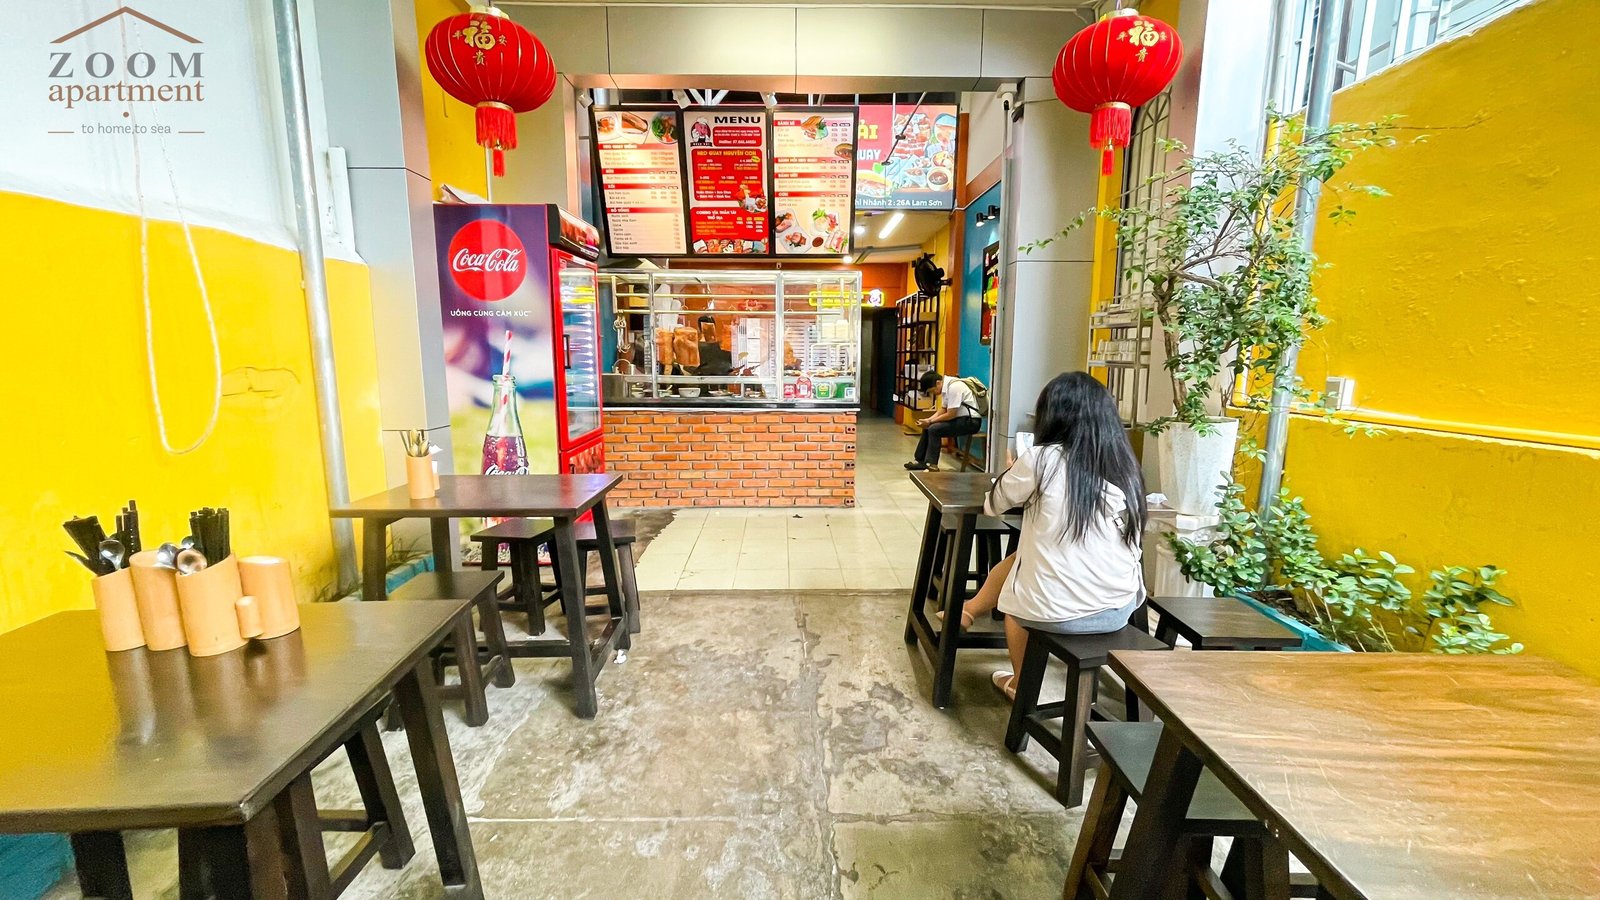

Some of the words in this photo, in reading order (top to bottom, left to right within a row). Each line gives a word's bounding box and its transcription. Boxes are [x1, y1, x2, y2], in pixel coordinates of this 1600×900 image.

[714, 116, 761, 124] MENU
[858, 119, 879, 140] ẢI
[857, 149, 881, 161] UAY
[453, 248, 522, 272] Coca-Cola
